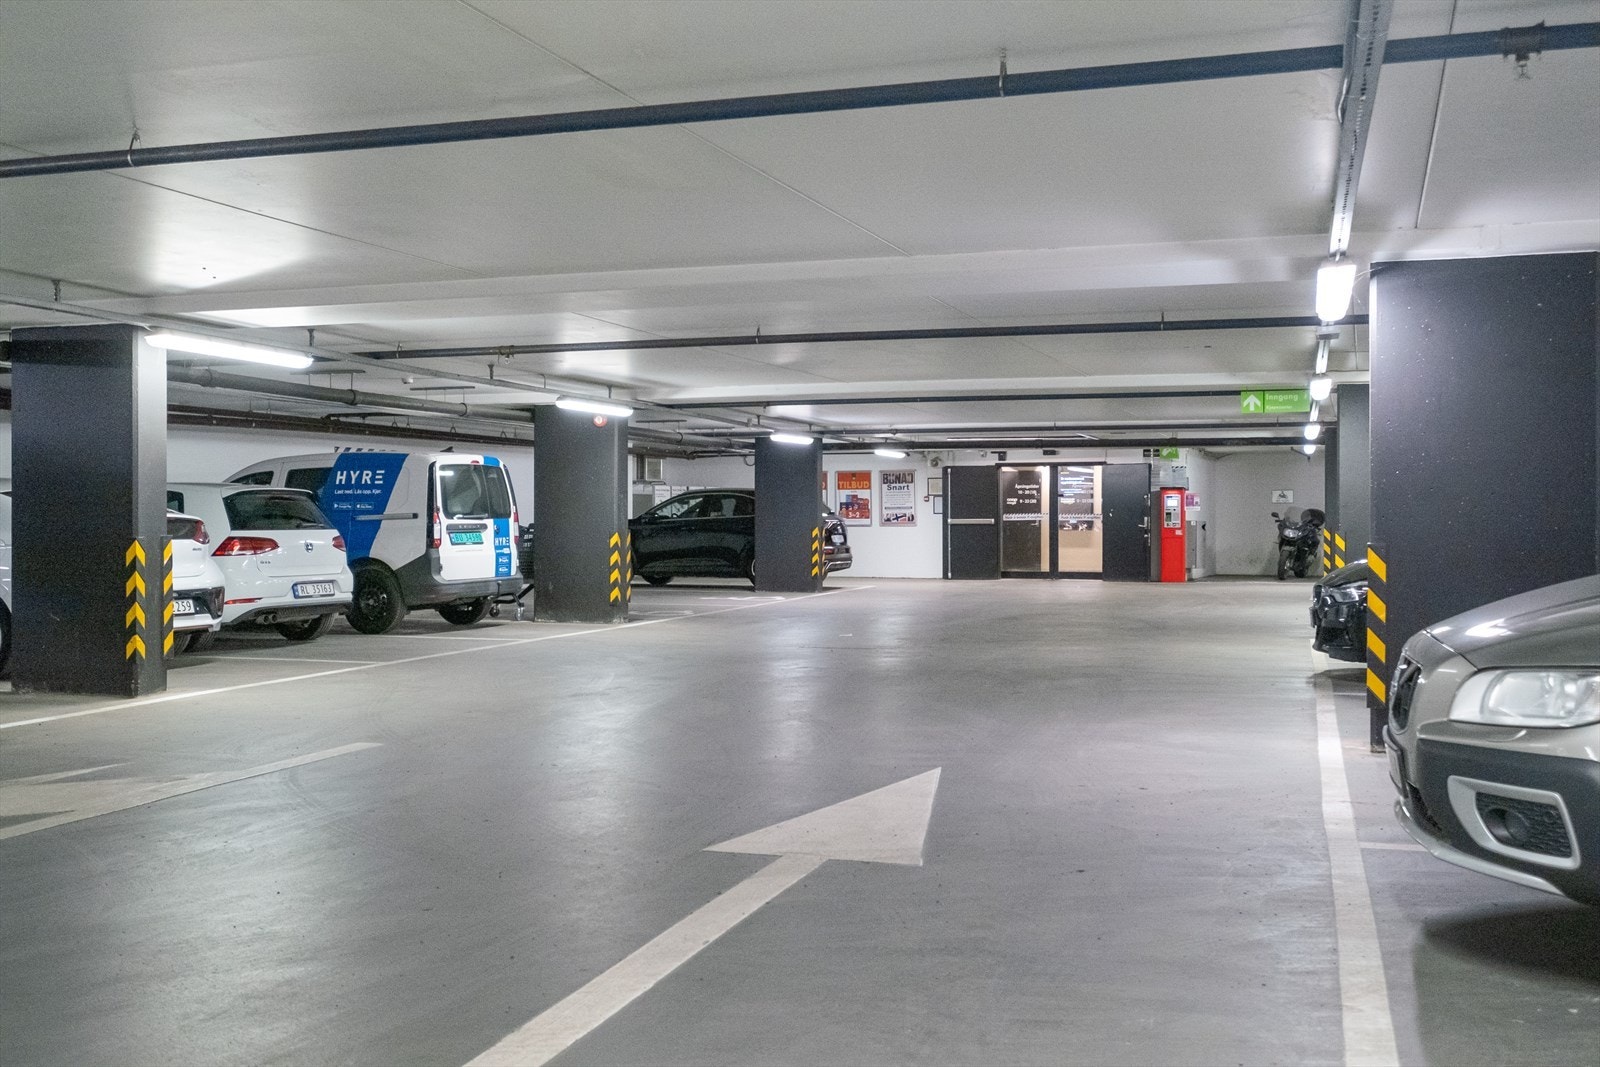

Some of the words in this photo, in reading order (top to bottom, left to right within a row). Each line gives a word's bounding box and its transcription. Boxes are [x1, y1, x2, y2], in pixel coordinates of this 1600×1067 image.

[1265, 393, 1298, 401] Inngang
[335, 470, 385, 485] HYRE
[882, 473, 914, 484] BUNAD
[839, 481, 870, 489] TILBUD
[300, 586, 310, 595] RL
[312, 584, 332, 593] 35163
